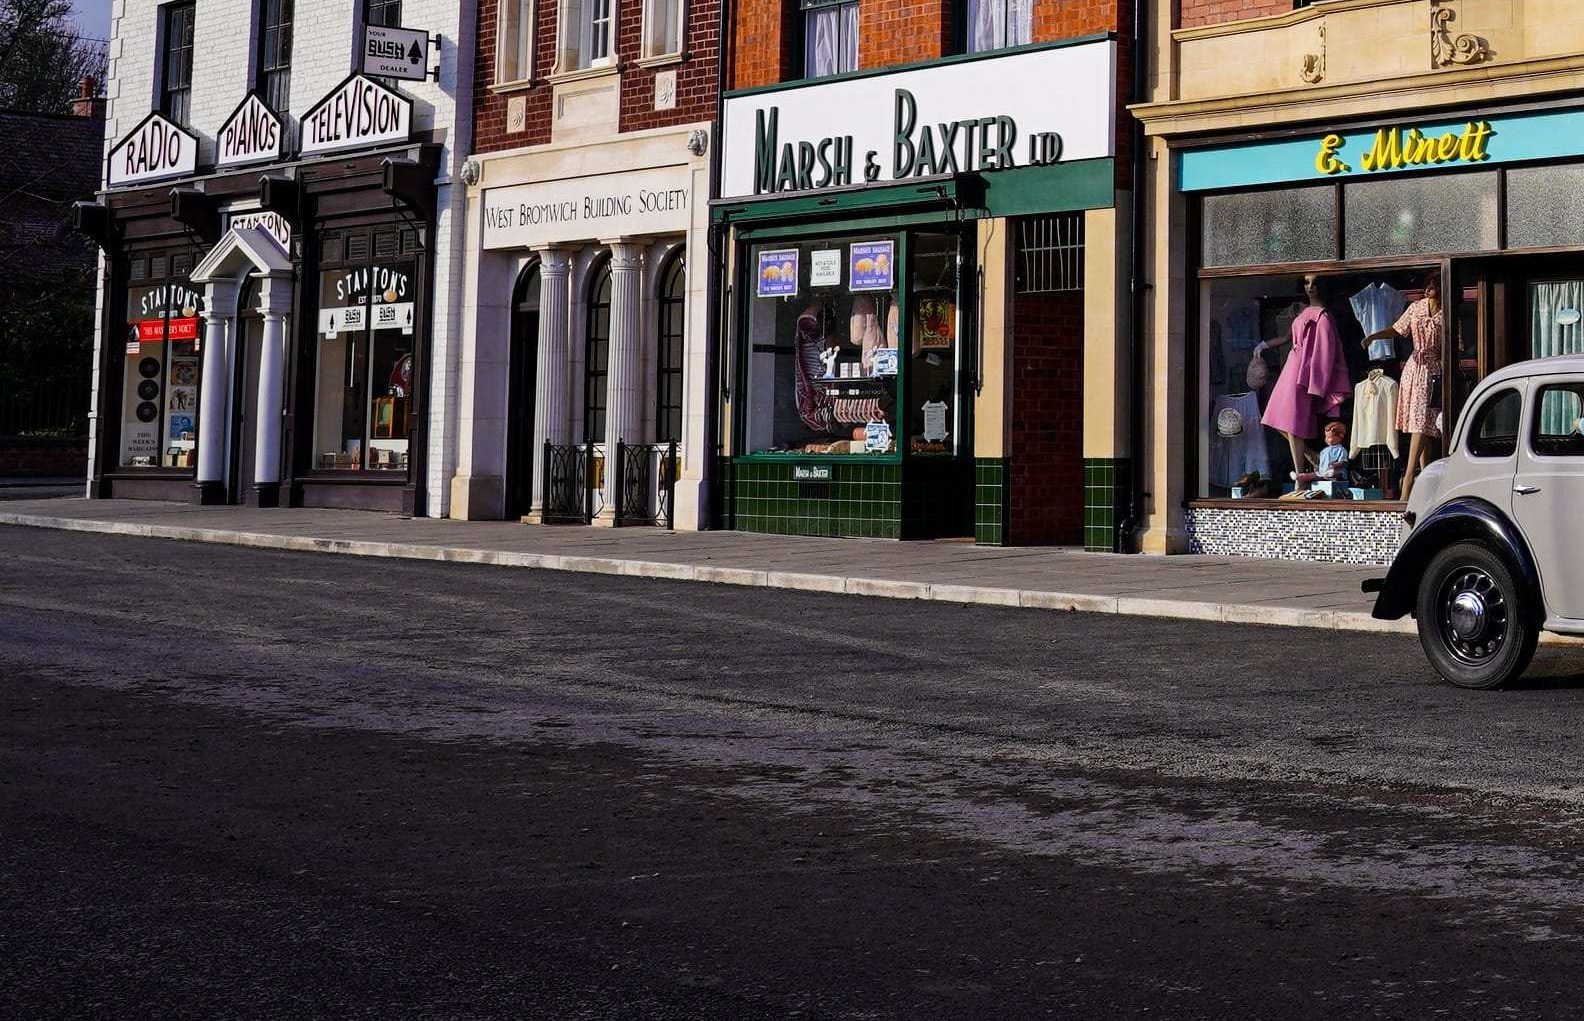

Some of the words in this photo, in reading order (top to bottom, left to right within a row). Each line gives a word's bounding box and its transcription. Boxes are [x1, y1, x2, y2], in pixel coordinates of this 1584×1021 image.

[367, 39, 405, 60] BUSH
[380, 64, 408, 73] DEALER
[225, 98, 277, 157] PIANOS
[311, 79, 400, 144] TELEVISION
[126, 120, 181, 175] RADIO
[754, 106, 853, 195] MARSH
[864, 150, 880, 181] &
[893, 88, 1017, 179] BAXTER
[1029, 132, 1063, 164] LTD
[1361, 120, 1498, 171] Minett
[486, 206, 514, 228] WEST
[519, 200, 578, 227] BROMWICH
[584, 195, 632, 220] BUILDING
[639, 188, 689, 214] SOCIETY
